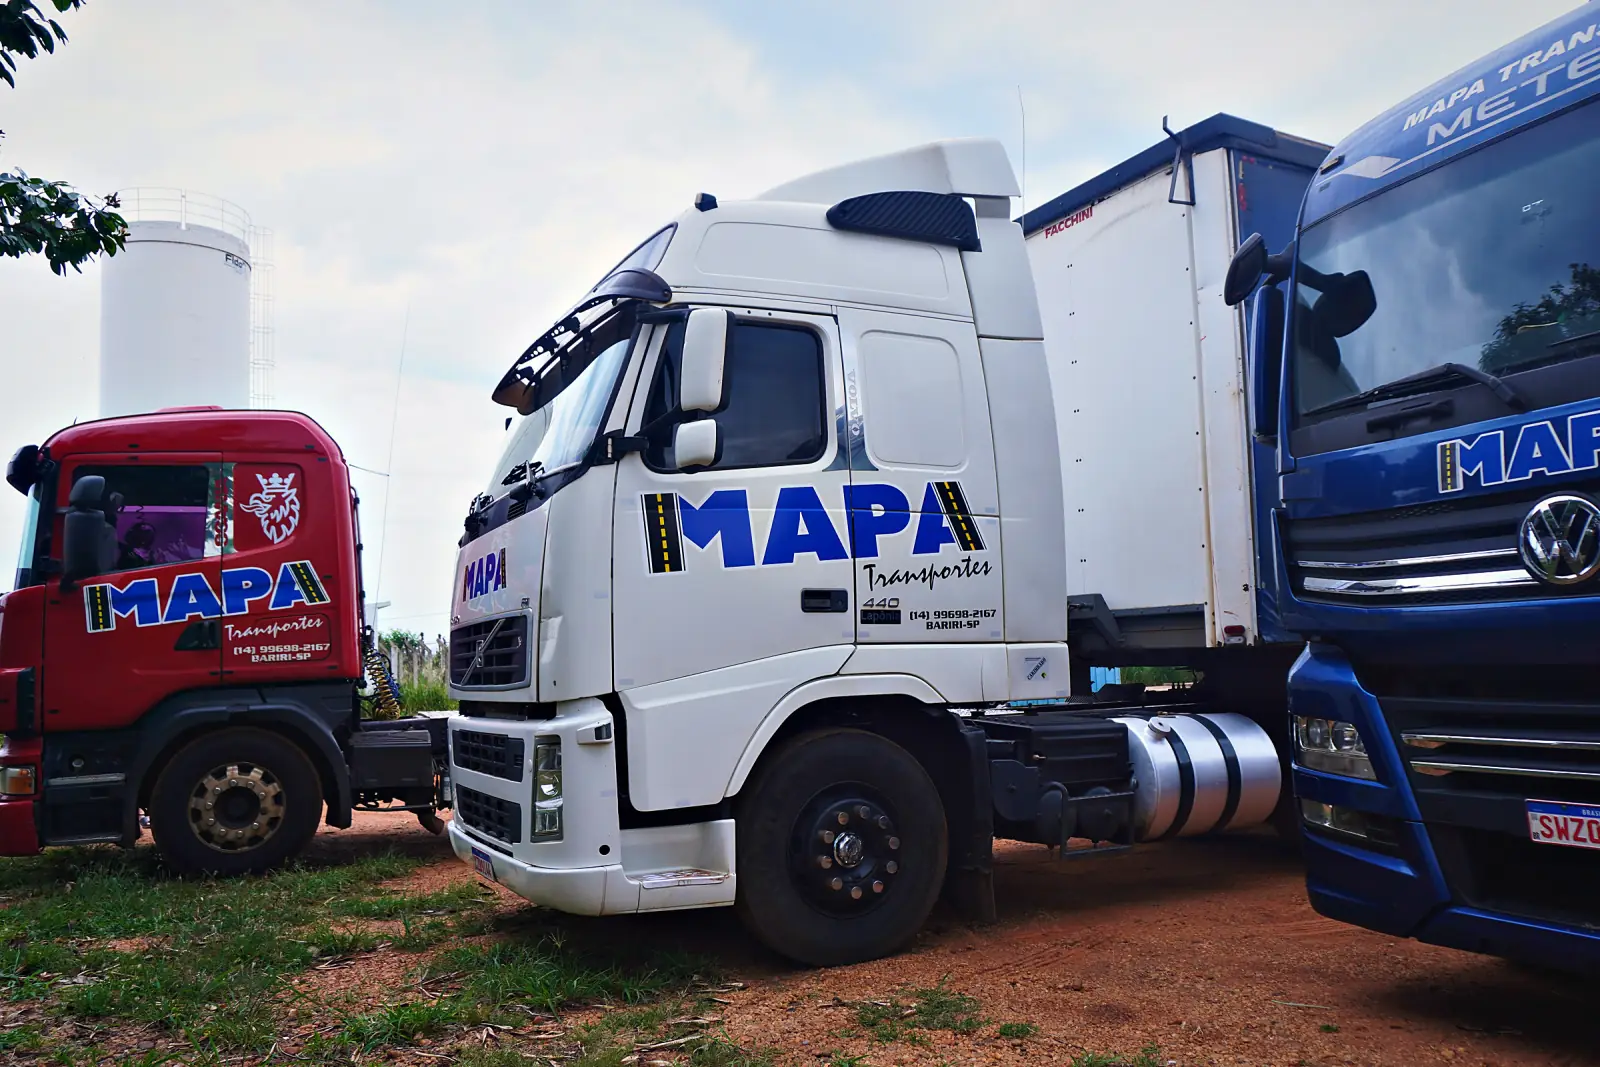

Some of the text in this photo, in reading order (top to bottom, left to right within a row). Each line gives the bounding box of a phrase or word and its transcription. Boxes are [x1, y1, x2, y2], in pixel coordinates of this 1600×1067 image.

[1402, 24, 1600, 131] MAPA TRAN
[1044, 206, 1093, 239] FACCHINI
[641, 481, 986, 573] MAPA
[463, 548, 507, 602] MAPA
[863, 555, 992, 591] Transportes
[83, 560, 330, 633] MAPA
[862, 597, 900, 608] 440
[224, 616, 323, 641] Transportes
[909, 609, 997, 620] (14) 99698-2167
[926, 620, 980, 630] BARIRI-SP
[233, 643, 330, 655] (14) 99698-2167
[251, 652, 311, 662] BARIRI-SP
